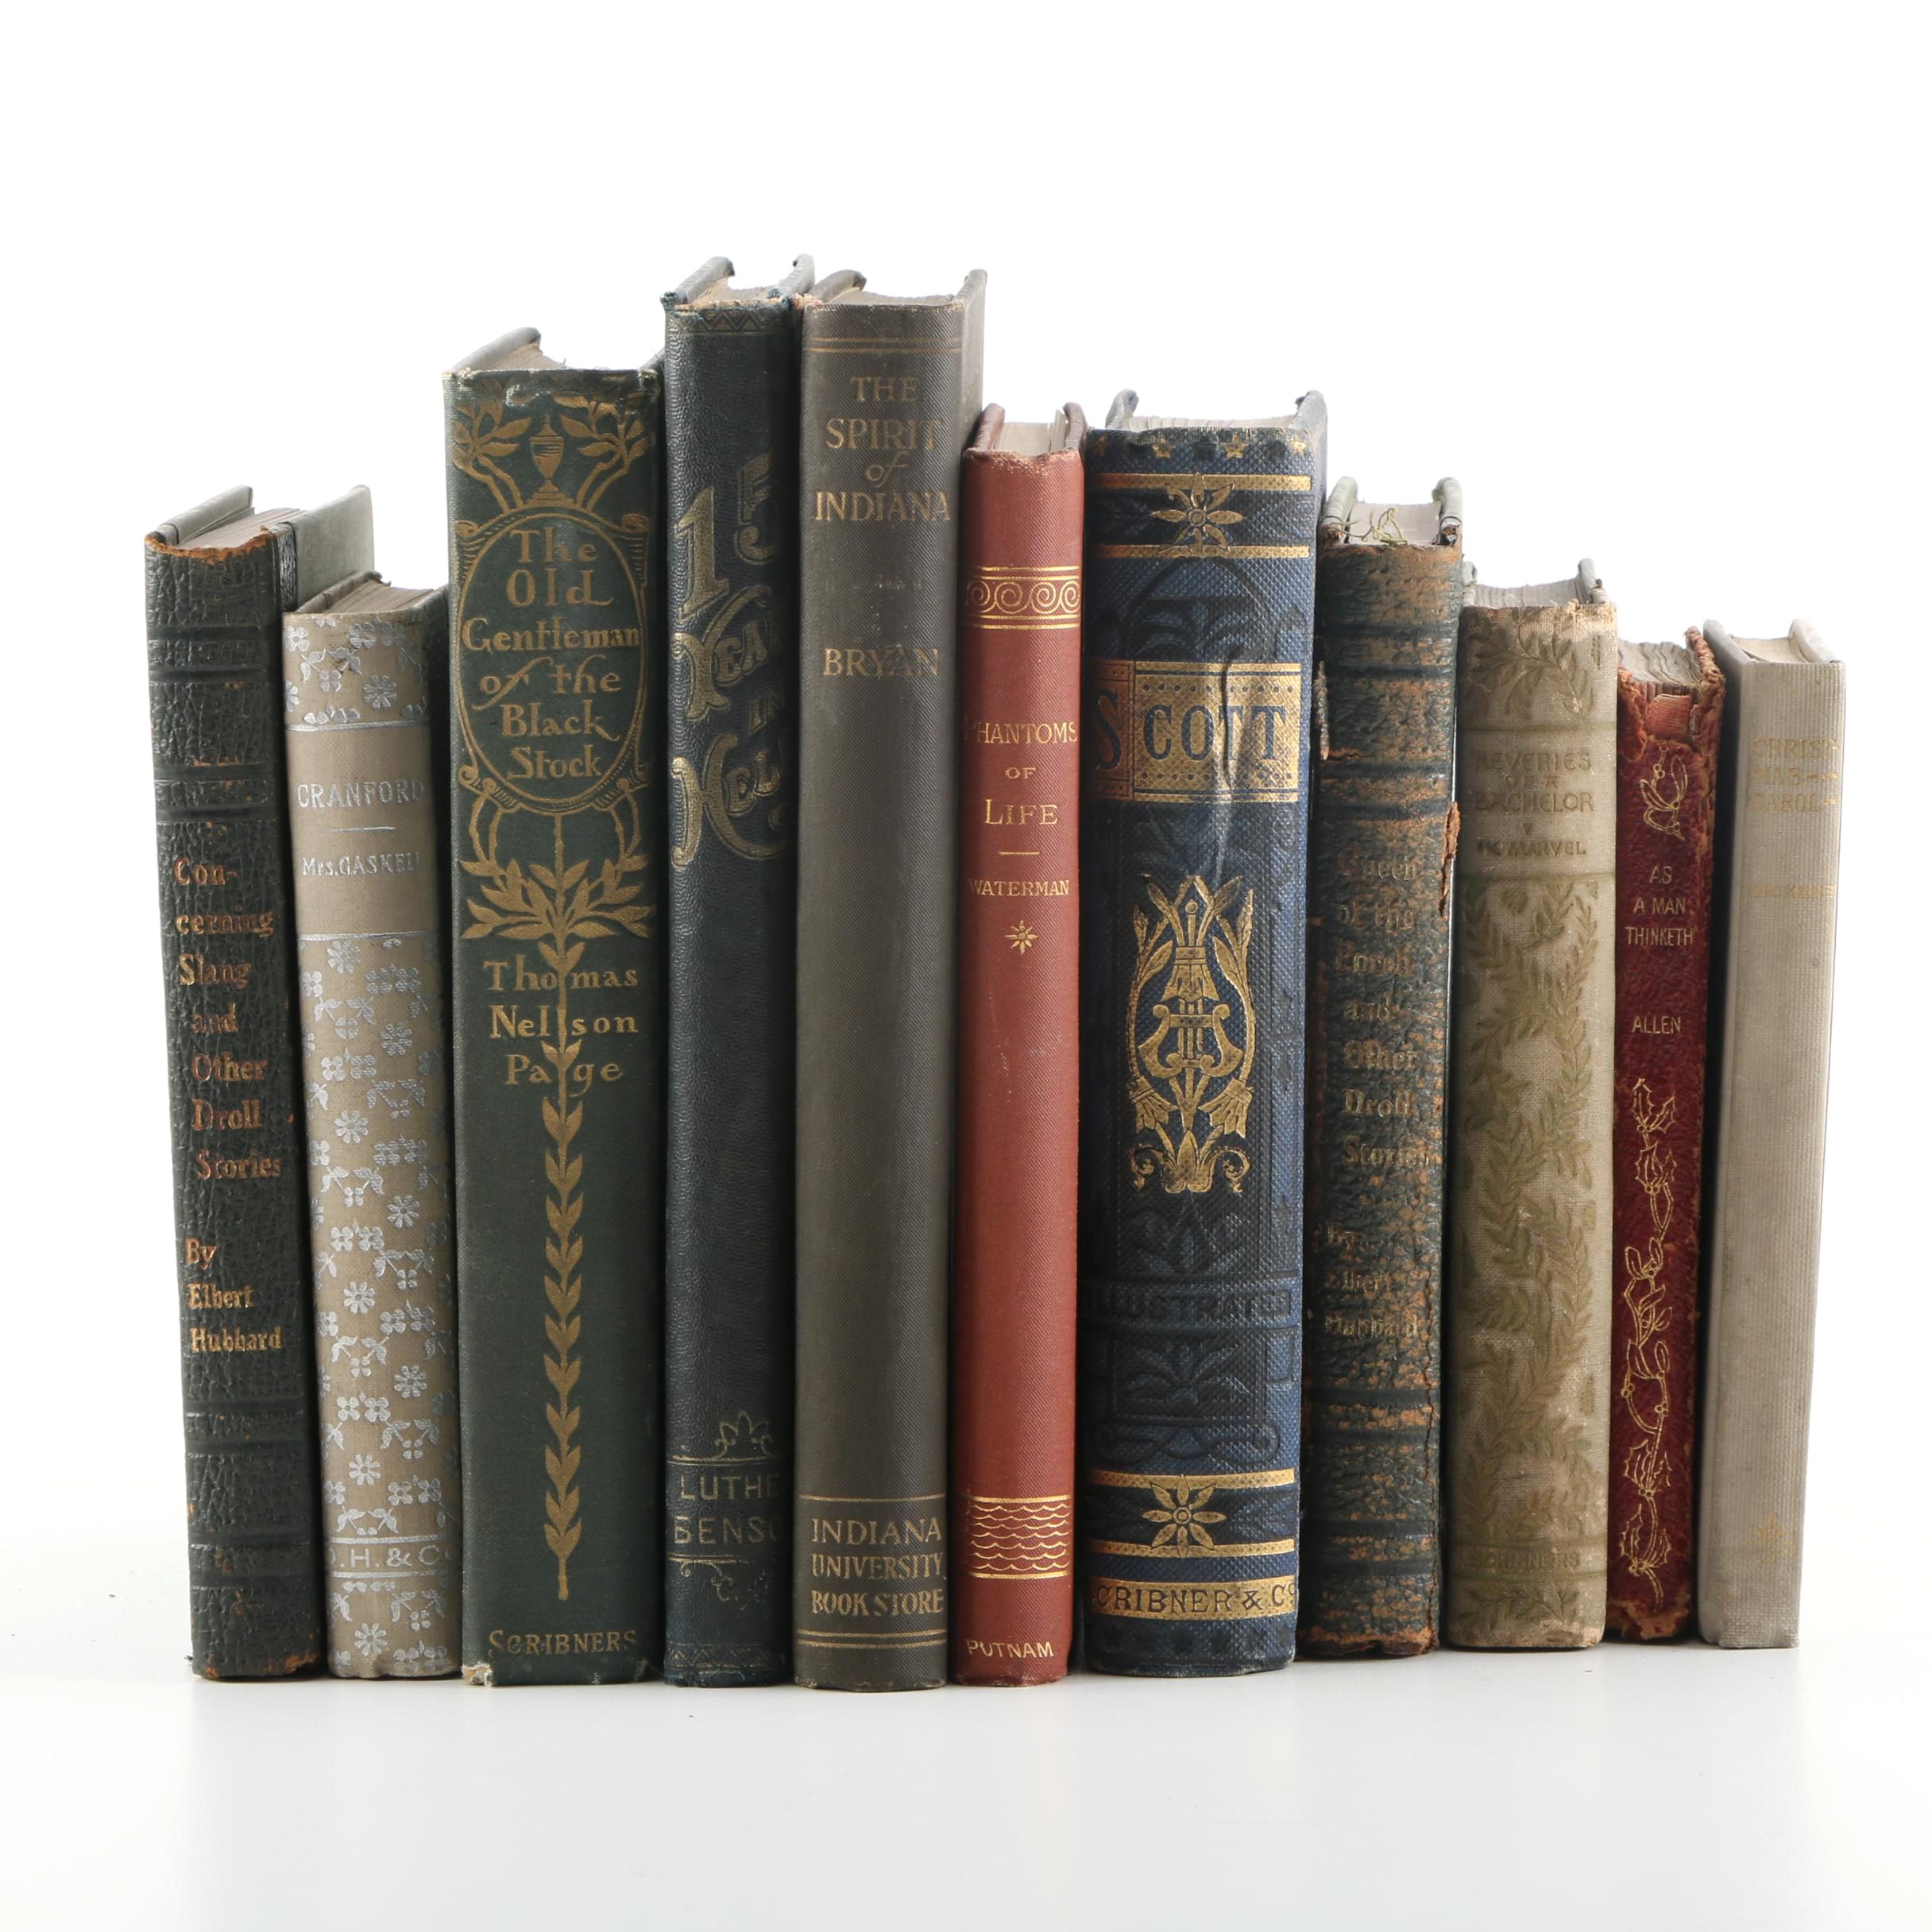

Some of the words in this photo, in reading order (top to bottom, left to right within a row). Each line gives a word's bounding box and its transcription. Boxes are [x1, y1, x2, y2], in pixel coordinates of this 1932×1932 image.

[851, 376, 922, 402] THE
[825, 417, 945, 450] SPIRIT
[864, 450, 911, 489] of
[813, 490, 952, 522] INDIANA
[509, 527, 597, 564] The
[506, 567, 614, 608] Old
[462, 616, 640, 654] Gentleman
[472, 656, 554, 711] of
[549, 655, 622, 694] the
[500, 699, 620, 742] Black
[963, 717, 1078, 745] PHANTOMS
[1093, 688, 1287, 771] SCOTT
[508, 745, 602, 779] Stock
[1005, 767, 1037, 779] OF
[297, 779, 424, 809] CRANFORD
[1474, 792, 1594, 813] BACHELOR
[984, 798, 1059, 826] LIFE
[173, 856, 238, 885] Con-
[1649, 866, 1672, 884] AS
[969, 879, 1070, 898] WATERMAN
[1633, 897, 1646, 914] A
[1652, 897, 1687, 914] MAN
[176, 904, 274, 939] cerning
[1625, 925, 1694, 947] THINKETH
[178, 953, 252, 990] Slang
[190, 1002, 238, 1034] and
[1631, 1015, 1682, 1034] ALLEN
[191, 1050, 269, 1082] Other
[191, 1098, 263, 1131] Droll
[196, 1149, 280, 1180] Stories
[185, 1236, 217, 1270] By
[187, 1283, 255, 1309] Elbert
[189, 1326, 283, 1352] Hubbard
[680, 1474, 780, 1501] LUTHE
[673, 1513, 782, 1545] BENSO
[811, 1517, 943, 1546] INDIANA
[811, 1551, 945, 1581] UNIVERSITY
[811, 1589, 869, 1616] BOOK
[873, 1589, 944, 1617] STORE
[1093, 1584, 1233, 1614] CRIBNER
[1242, 1589, 1263, 1611] &
[488, 1629, 636, 1657] SCRIBNERS
[966, 1638, 1055, 1659] PUTNAM
